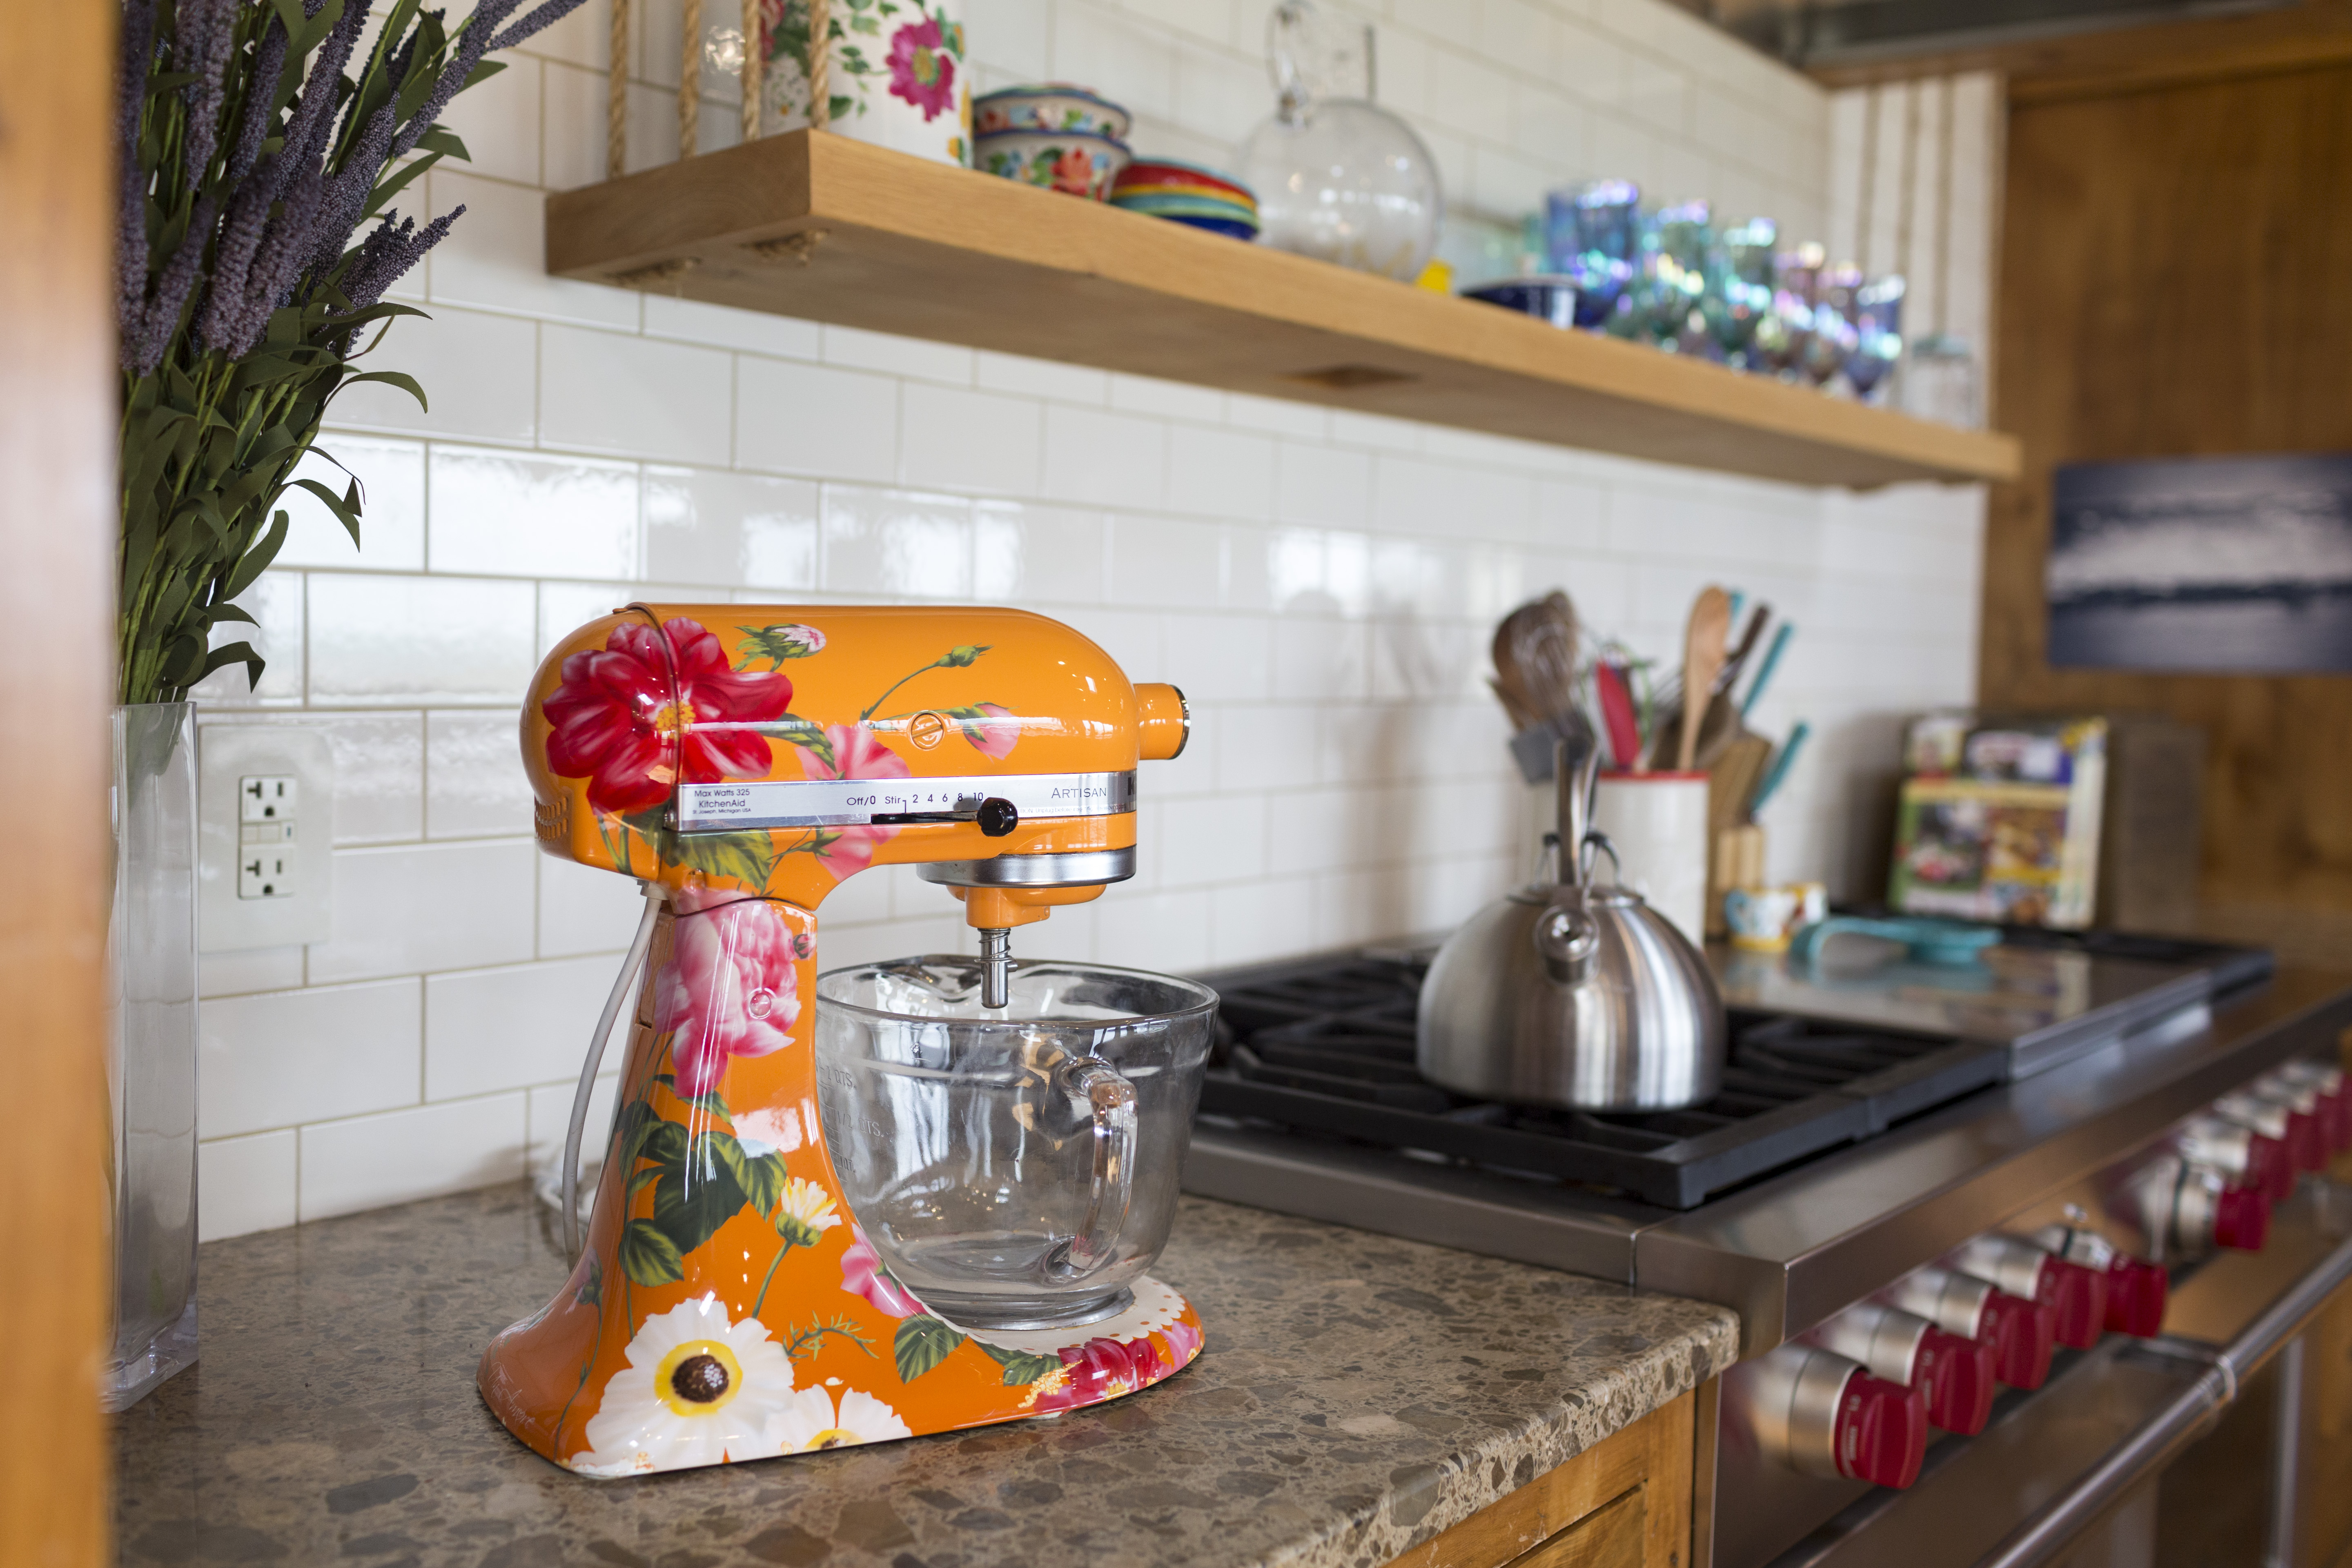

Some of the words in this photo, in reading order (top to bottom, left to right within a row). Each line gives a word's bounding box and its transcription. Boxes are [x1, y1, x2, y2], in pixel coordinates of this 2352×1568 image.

[846, 795, 876, 806] Off/0
[885, 796, 901, 804] Stir
[913, 794, 918, 803] 2
[927, 794, 933, 802] 4
[942, 793, 948, 802] 6
[958, 793, 963, 802] 8
[973, 792, 983, 801] 10
[1051, 788, 1106, 798] ARTISAN
[699, 799, 745, 808] KitchenAid
[834, 1069, 857, 1089] QTS.
[858, 1118, 884, 1137] QTS.
